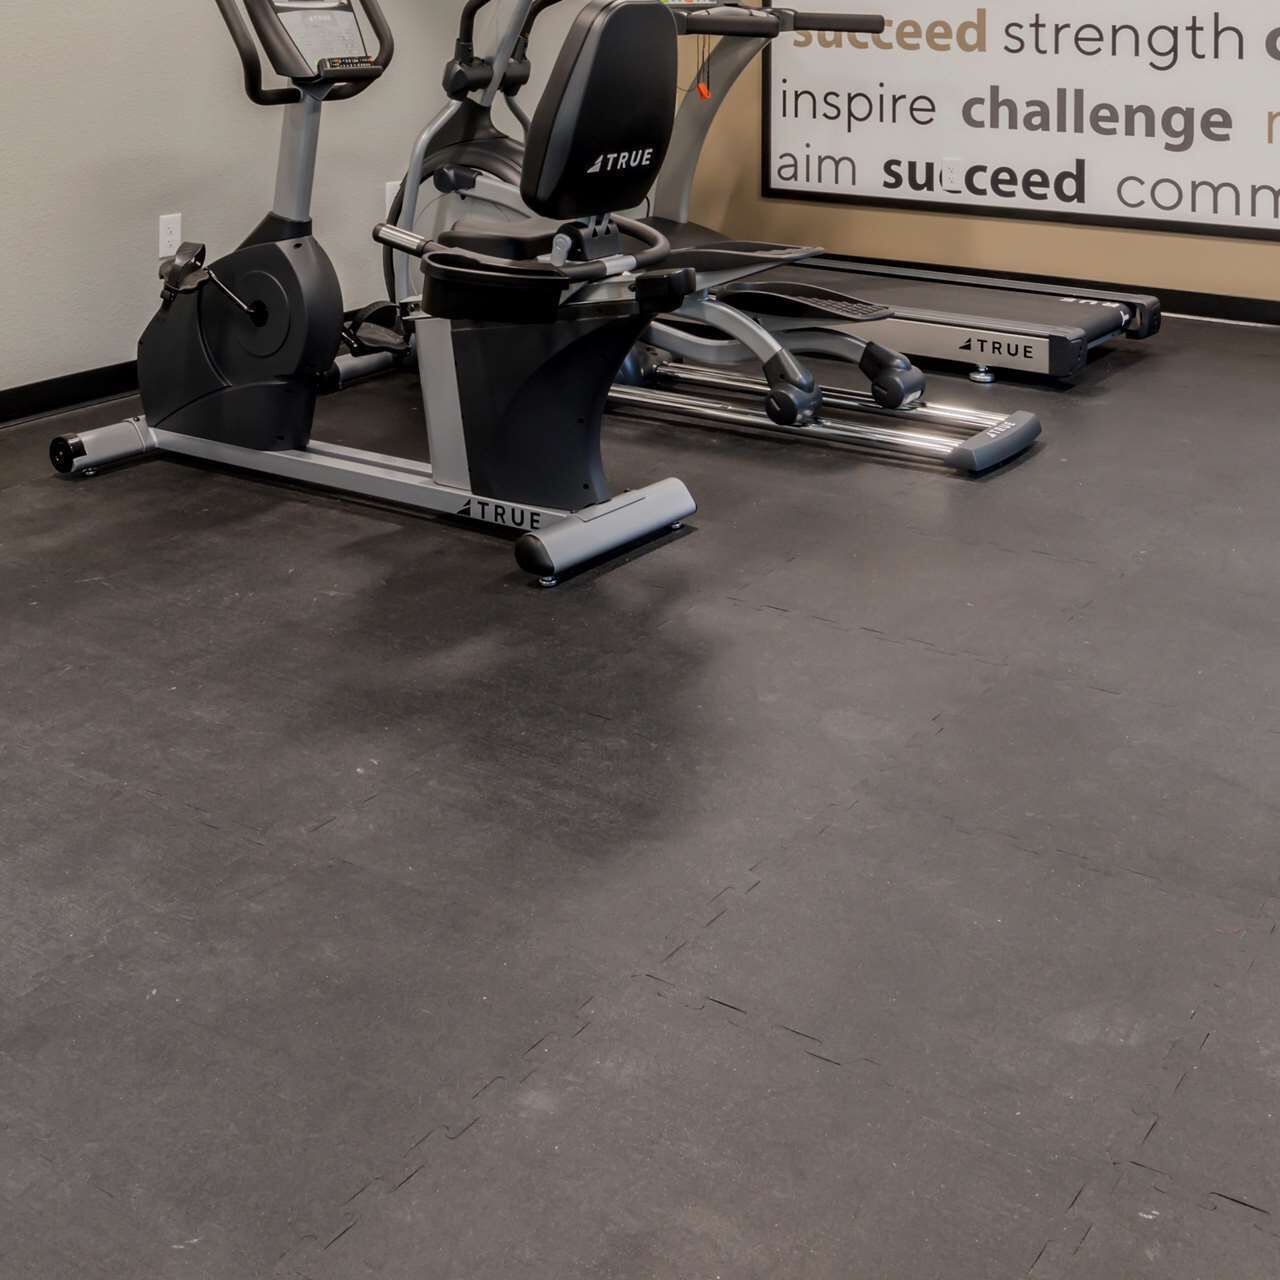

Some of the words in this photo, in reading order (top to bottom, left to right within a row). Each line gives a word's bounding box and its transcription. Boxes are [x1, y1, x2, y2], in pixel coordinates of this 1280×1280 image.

[1002, 11, 1245, 72] strength
[781, 76, 937, 133] inspire
[961, 84, 1233, 153] challenge
[606, 148, 653, 171] TRUE
[776, 142, 857, 187] aim
[882, 158, 1086, 204] suceed
[977, 338, 1033, 359] TRUE
[477, 501, 541, 530] TRUE
